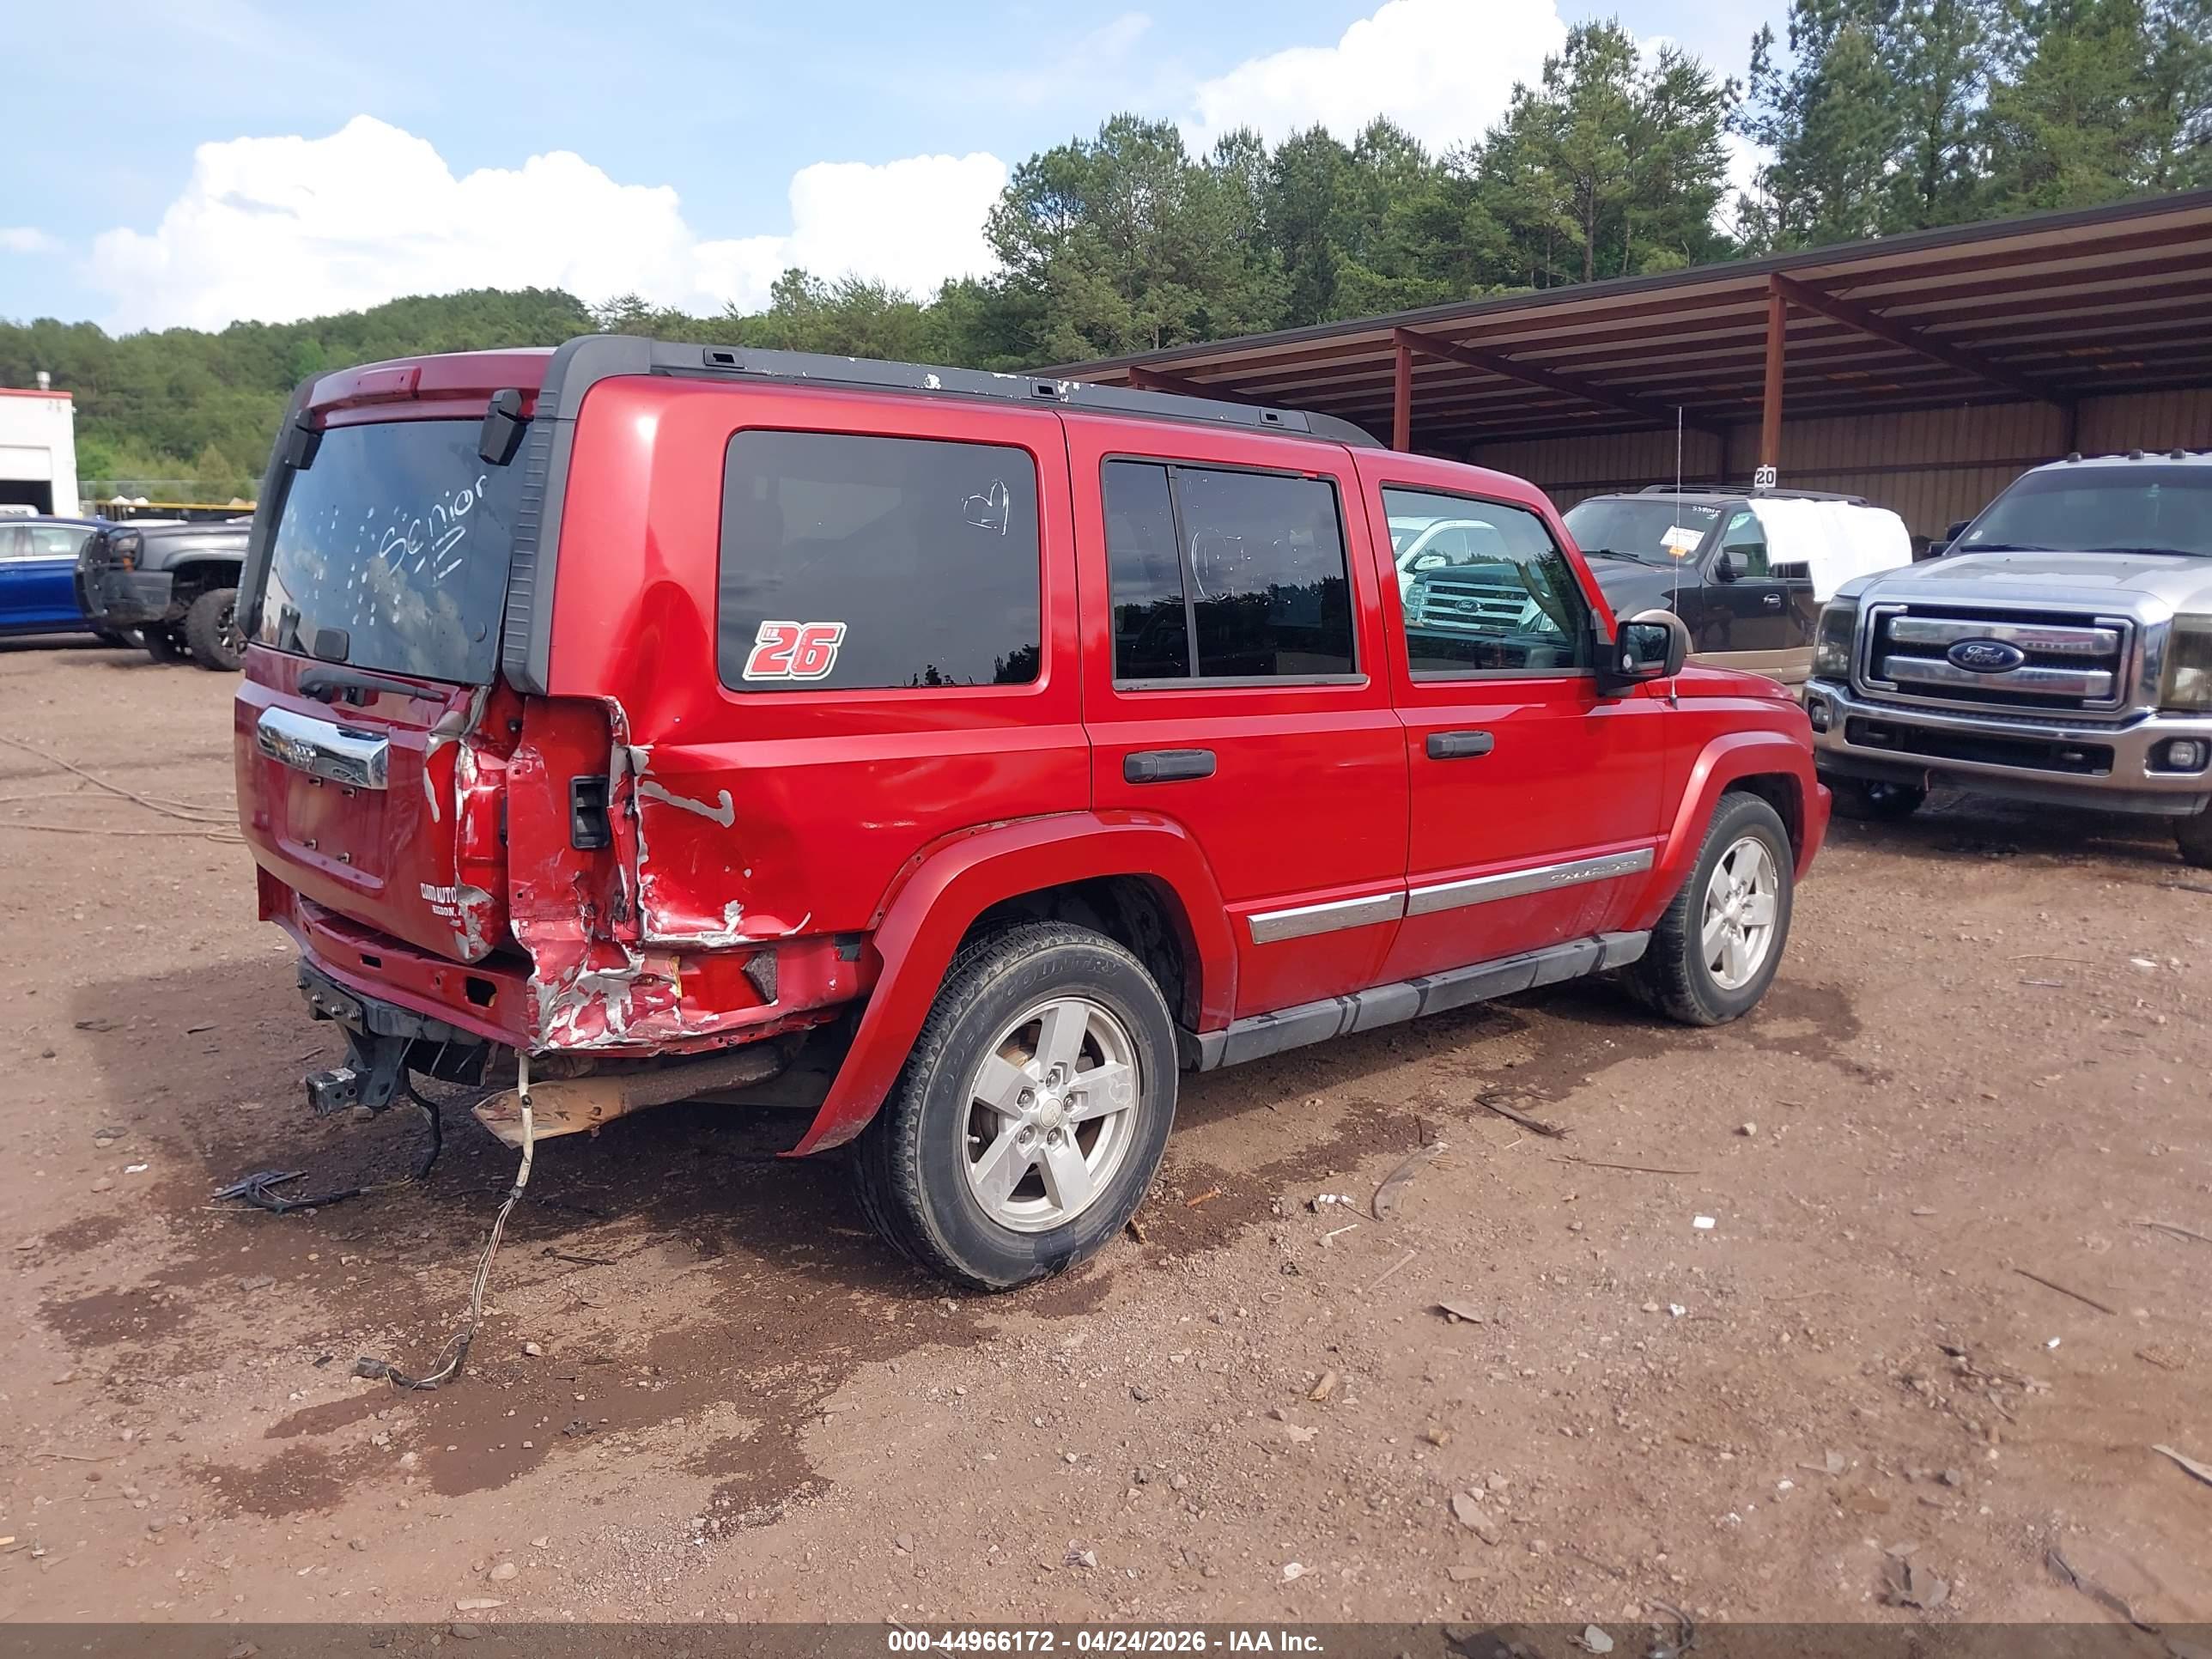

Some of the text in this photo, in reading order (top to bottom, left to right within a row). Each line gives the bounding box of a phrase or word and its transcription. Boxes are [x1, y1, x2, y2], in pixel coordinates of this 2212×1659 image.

[1757, 470, 1775, 484] 20
[742, 620, 848, 681] 26
[1963, 645, 2005, 664] Ford
[436, 886, 458, 904] AUTO
[1003, 954, 1121, 1001] COUNTRY
